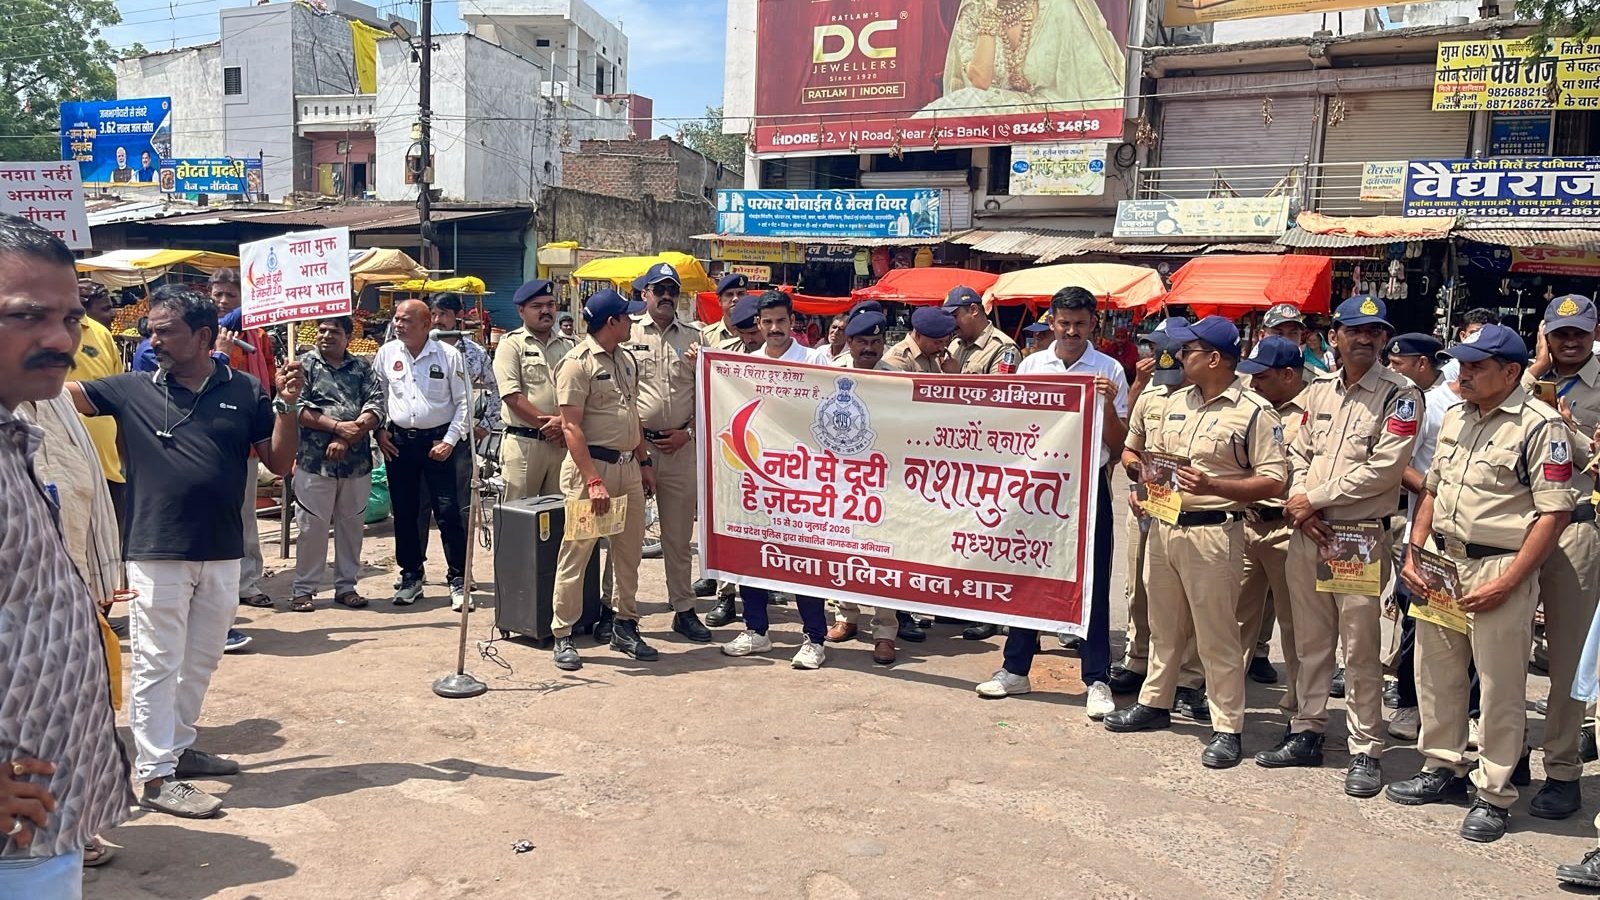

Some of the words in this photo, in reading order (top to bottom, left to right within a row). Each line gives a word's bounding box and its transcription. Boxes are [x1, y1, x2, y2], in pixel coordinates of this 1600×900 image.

[832, 12, 879, 21] RATLAM'S
[813, 19, 897, 63] DC
[1462, 44, 1489, 60] (SEX)
[812, 60, 896, 74] JEWELLERS
[1438, 66, 1459, 82] यौन
[1462, 64, 1488, 81] रोगी
[1491, 44, 1522, 84] वैद्य
[1566, 61, 1575, 71] से
[808, 88, 846, 98] RATLAM
[860, 86, 899, 95] INDORE
[1562, 80, 1575, 89] या
[1564, 93, 1575, 106] के
[99, 121, 116, 134] 3.62
[117, 123, 130, 133] लाख
[131, 123, 141, 132] जल
[827, 133, 836, 144] 2,
[839, 132, 847, 141] Y
[850, 131, 859, 141] N
[862, 130, 894, 142] Road,
[957, 125, 989, 137] Bank
[1057, 120, 1100, 132] 34858
[0, 170, 35, 183] नशा
[41, 164, 72, 183] नहीं
[176, 160, 209, 179] होटल
[1472, 160, 1496, 170] रोगी
[1500, 160, 1523, 170] मिलें
[1542, 160, 1585, 169] शनिवार
[7, 185, 74, 201] अनमोल
[184, 181, 198, 191] वेज
[748, 198, 783, 210] परमार
[785, 194, 832, 212] मोबाईल
[834, 196, 843, 210] &
[846, 194, 873, 210] मेन्स
[875, 194, 908, 210] वियर
[1407, 208, 1513, 217] 9826882196,
[289, 240, 311, 256] नशा
[314, 237, 336, 257] मुक्त
[300, 262, 328, 277] भारत
[285, 285, 312, 301] स्वस्थ
[316, 281, 344, 296] भारत
[244, 313, 266, 325] जिला
[269, 308, 297, 323] पुलिस
[326, 302, 346, 311] धार
[716, 365, 731, 377] नशे
[733, 366, 741, 378] से
[744, 365, 765, 380] चिंता
[768, 371, 781, 383] दूर
[782, 370, 804, 382] होना
[755, 385, 774, 397] मात्र
[775, 387, 792, 397] एक
[794, 388, 811, 398] भ्रम
[920, 384, 954, 399] नशा
[958, 387, 987, 404] एक
[990, 384, 1066, 406] अभिशाप
[763, 446, 810, 479] नशे
[815, 450, 838, 483] से
[843, 453, 887, 496] दूरी
[742, 472, 759, 510] है
[843, 495, 882, 523] 2.0
[904, 458, 1070, 528] नशामुक्त
[784, 517, 791, 528] से
[805, 522, 828, 535] जुलाई
[829, 525, 850, 534] 2026
[743, 525, 760, 536] प्रदेश
[762, 528, 781, 540] पुलिस
[782, 532, 796, 542] द्वारा
[798, 532, 825, 546] संचालित
[860, 542, 890, 553] अभियान
[951, 529, 1053, 569] मध्यप्रदेश
[760, 544, 822, 576] जिला
[827, 556, 903, 588] पुलिस
